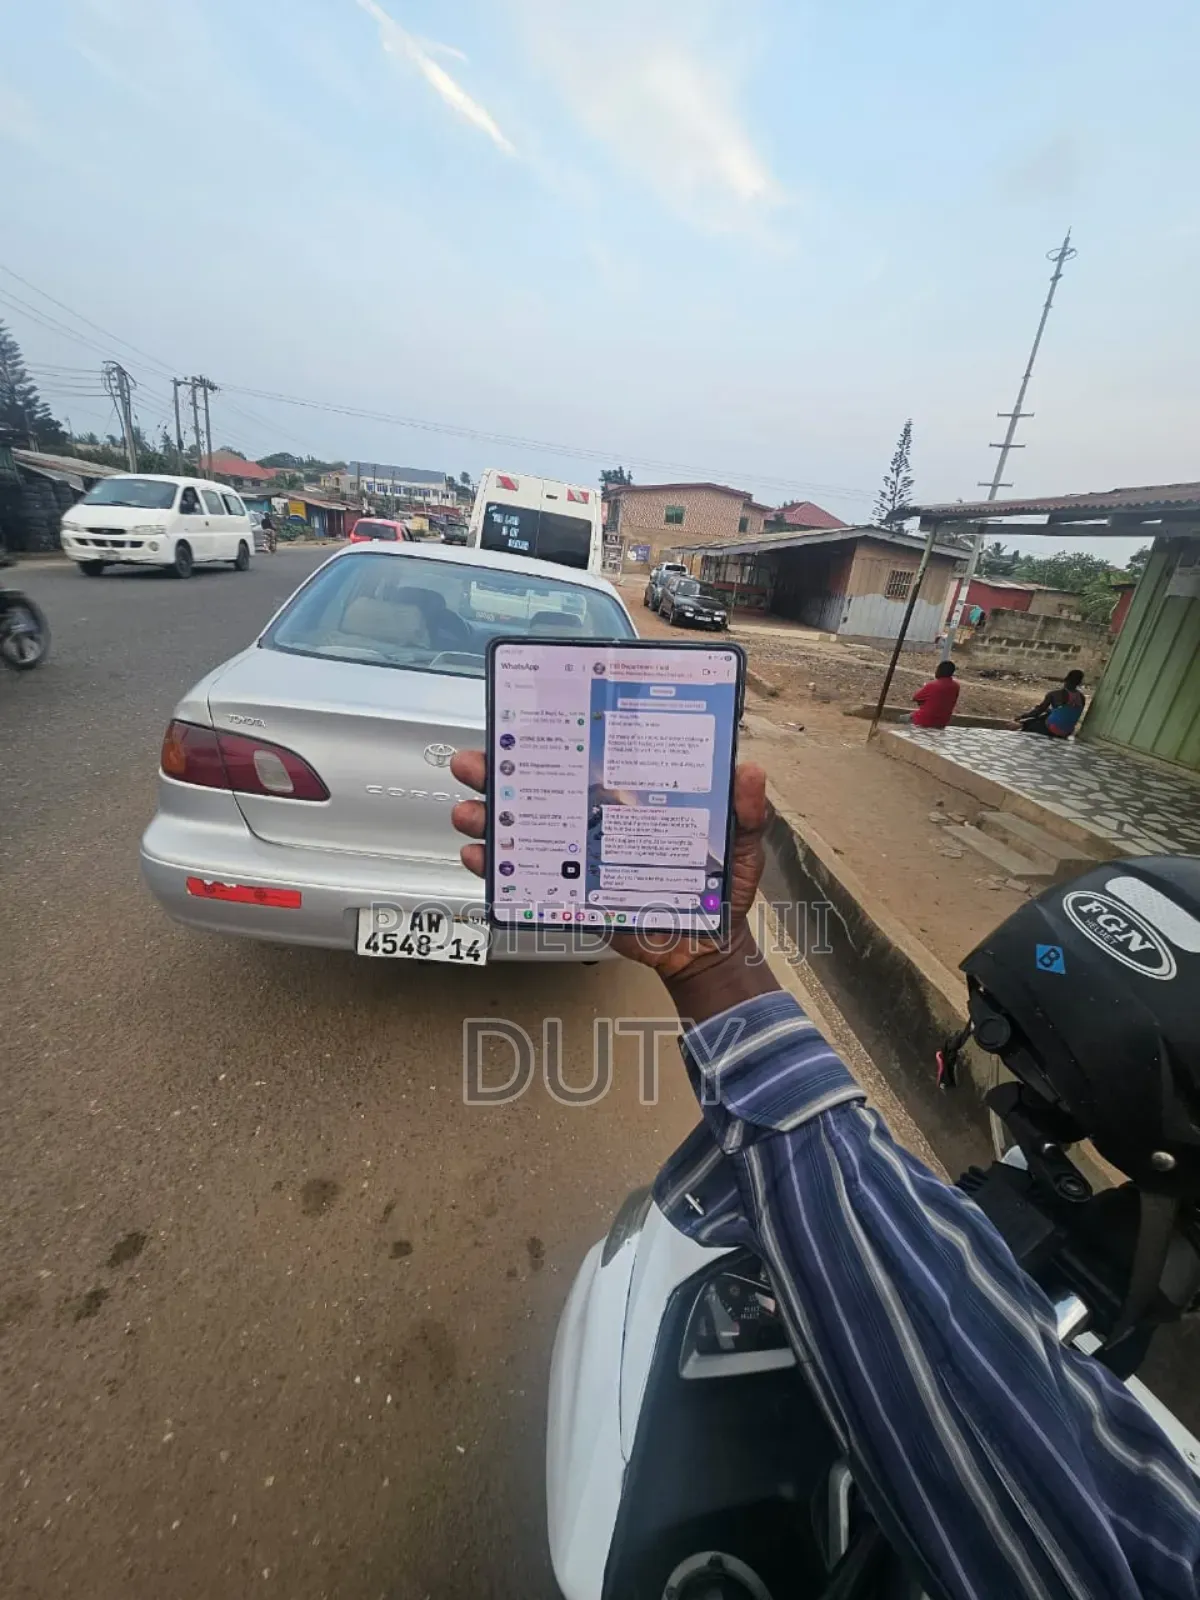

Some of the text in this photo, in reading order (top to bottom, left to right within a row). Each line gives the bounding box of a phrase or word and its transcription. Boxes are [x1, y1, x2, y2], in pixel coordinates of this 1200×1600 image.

[500, 663, 540, 671] WhatsApp
[228, 714, 267, 728] TOYOTA
[410, 912, 443, 933] AW
[1078, 901, 1156, 952] FGN
[1085, 919, 1119, 946] HELMET
[365, 932, 481, 962] 4548-14
